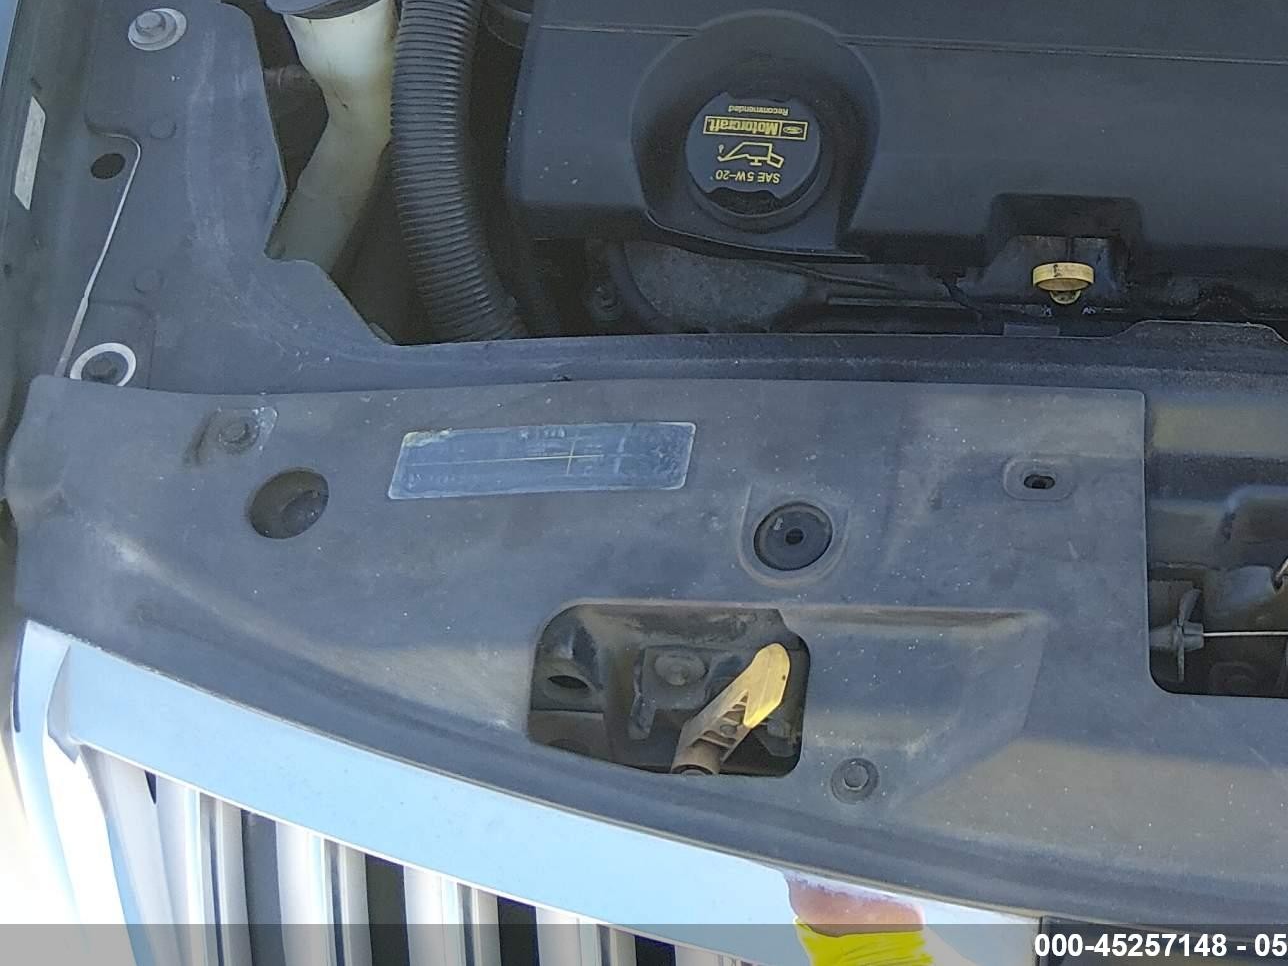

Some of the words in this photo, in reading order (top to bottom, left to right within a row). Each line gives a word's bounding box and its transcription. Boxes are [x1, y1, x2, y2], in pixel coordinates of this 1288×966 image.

[728, 105, 789, 116] Recommended
[709, 119, 779, 135] Motorcraft
[715, 170, 755, 182] 5W-20
[757, 172, 781, 184] SAE
